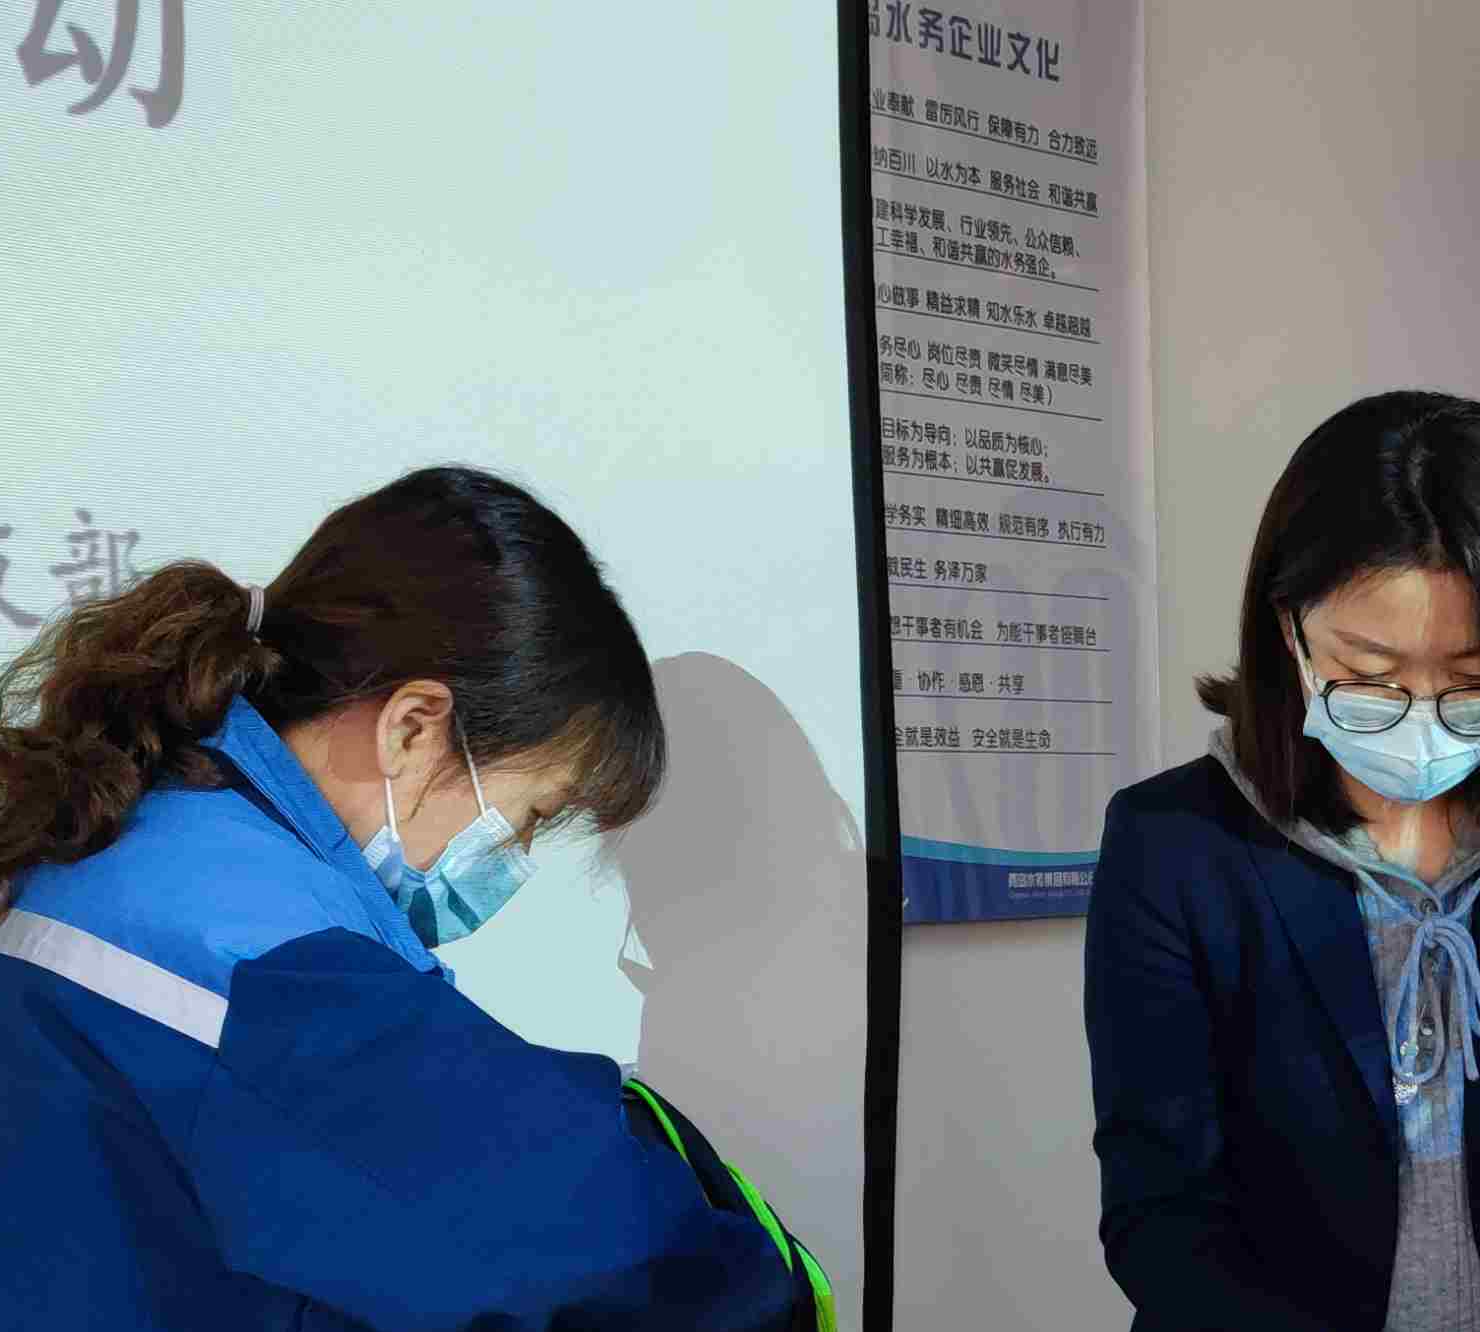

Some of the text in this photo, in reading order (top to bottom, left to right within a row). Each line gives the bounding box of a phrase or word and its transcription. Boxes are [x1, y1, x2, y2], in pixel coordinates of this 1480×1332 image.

[988, 113, 1040, 146] 保障有力
[1048, 129, 1097, 160] 合力致远
[926, 156, 982, 186] 以水为本
[990, 169, 1040, 200] 服务社会
[1048, 182, 1097, 212] 和谐共赢
